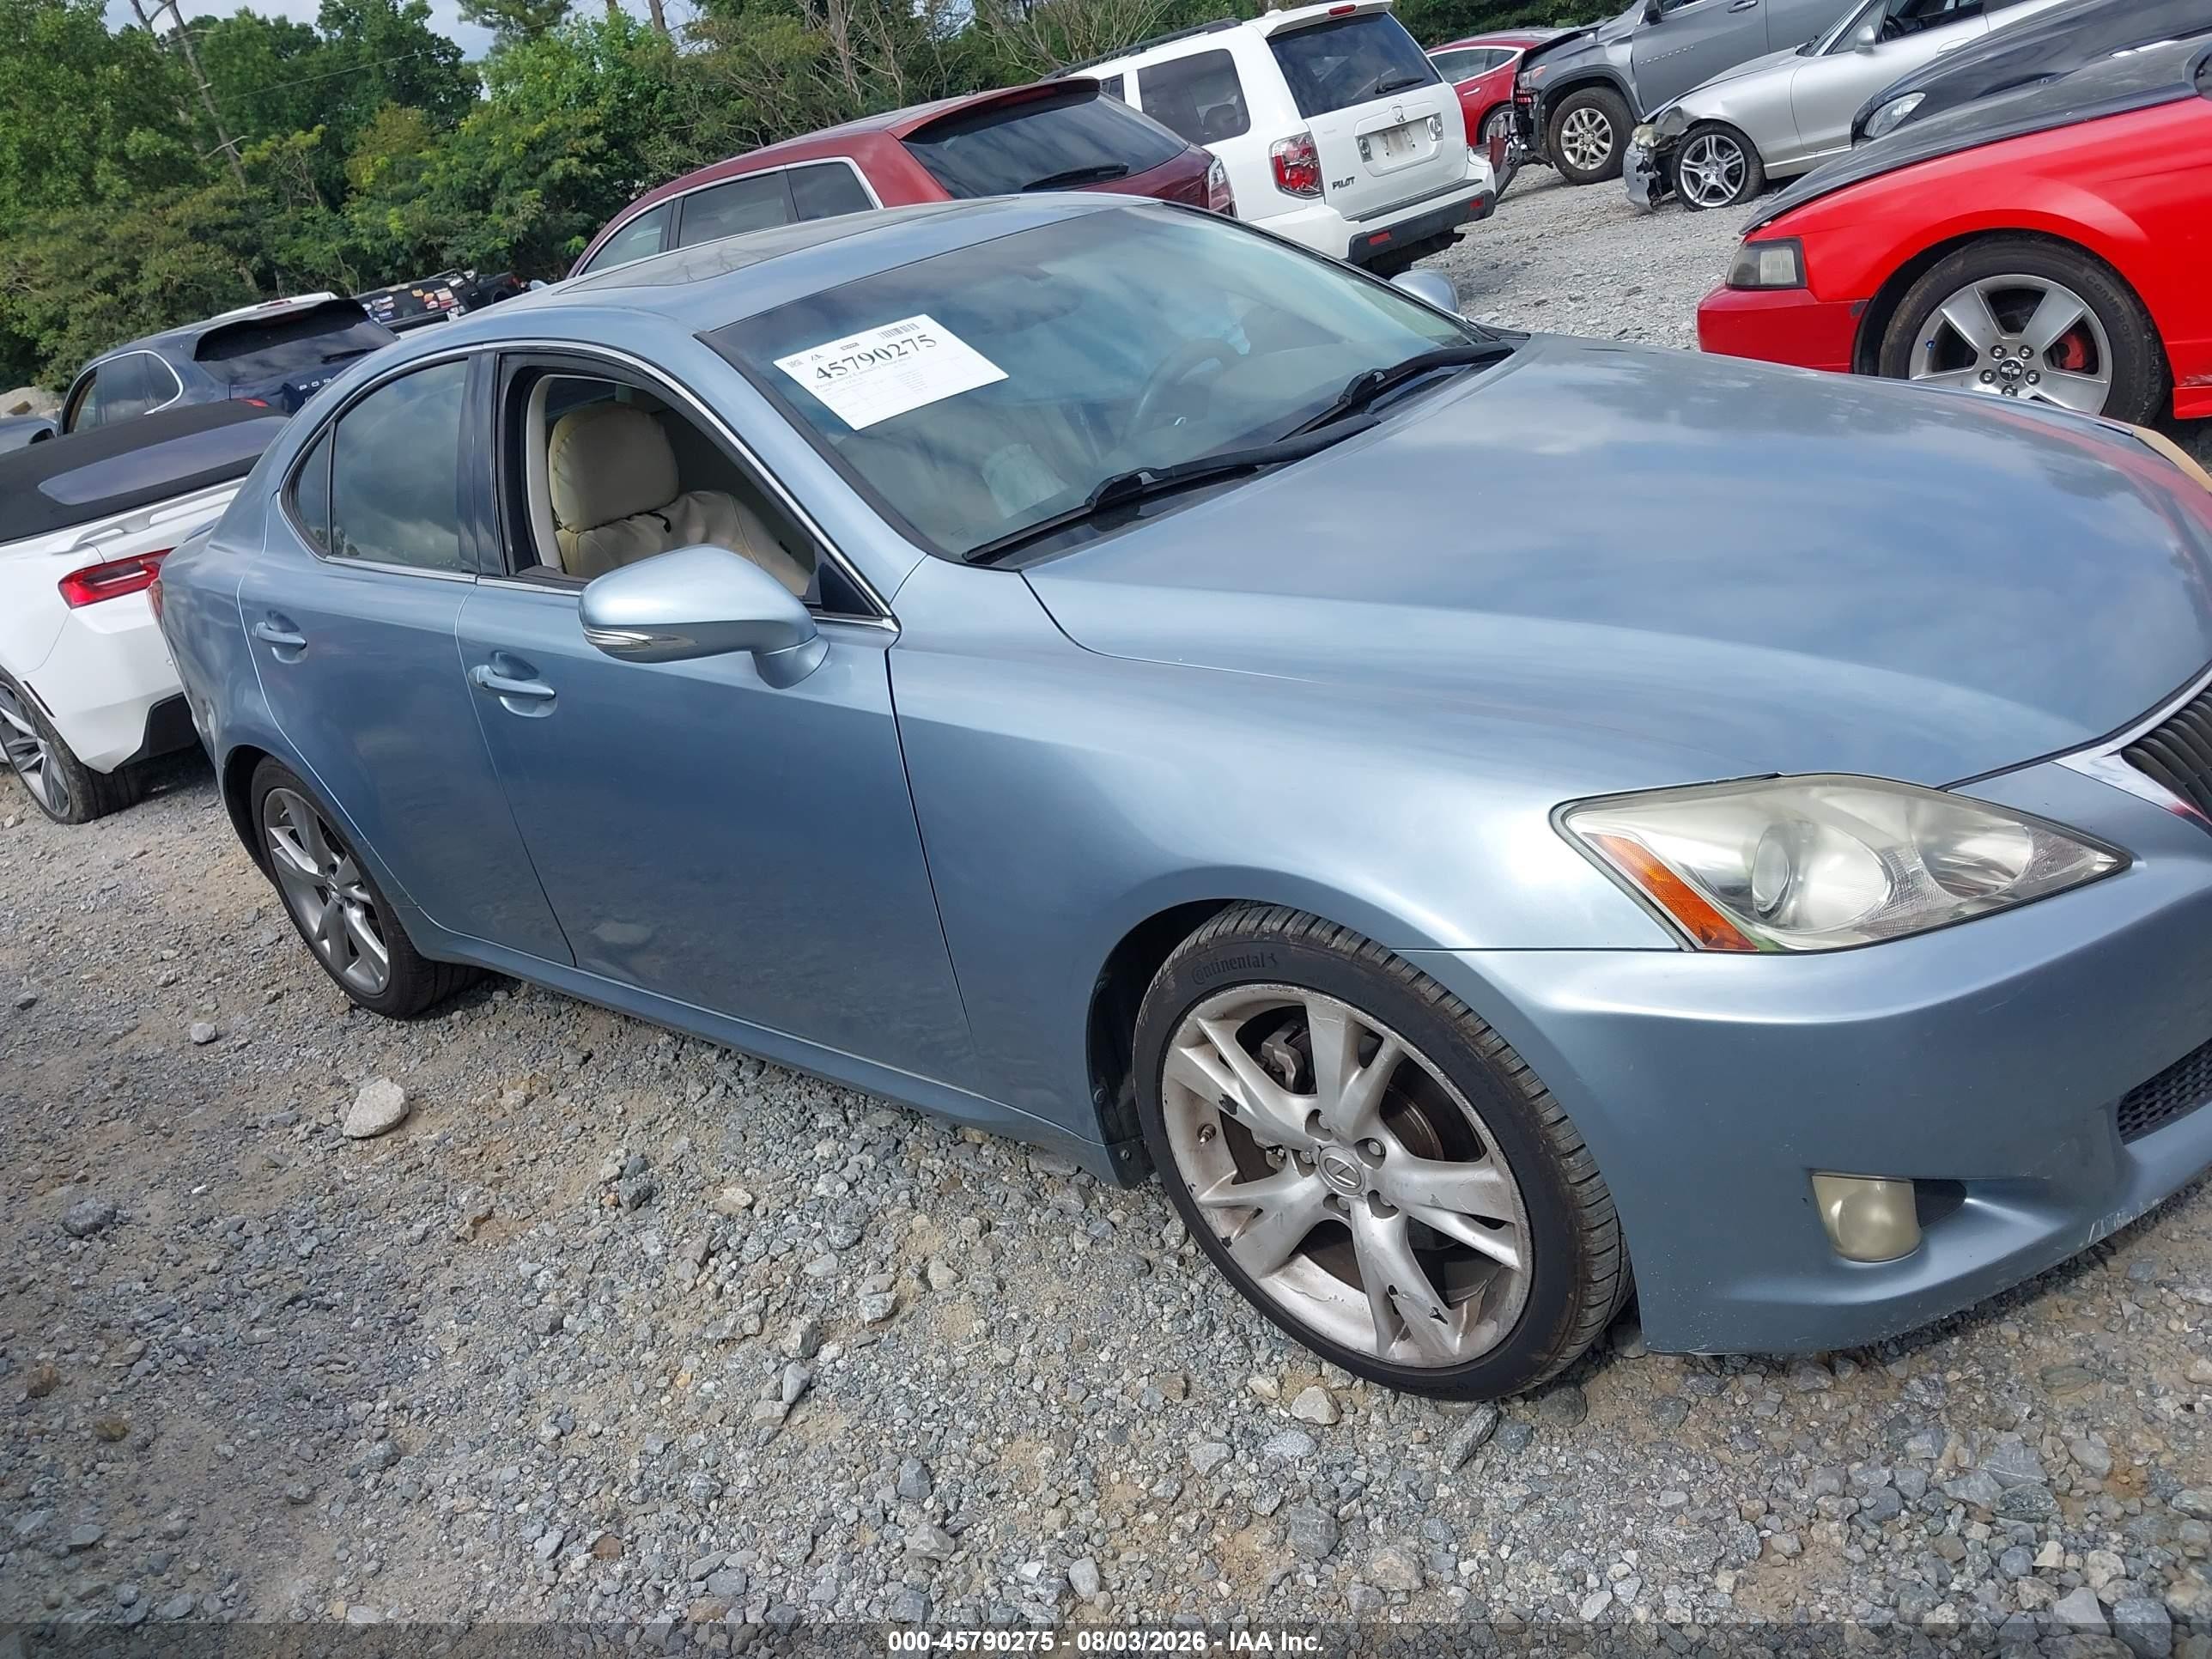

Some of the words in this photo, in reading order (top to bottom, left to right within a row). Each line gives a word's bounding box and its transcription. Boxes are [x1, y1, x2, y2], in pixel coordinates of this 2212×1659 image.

[1332, 176, 1355, 190] PILOT
[817, 334, 938, 379] 45790275
[1191, 951, 1265, 985] Continental
